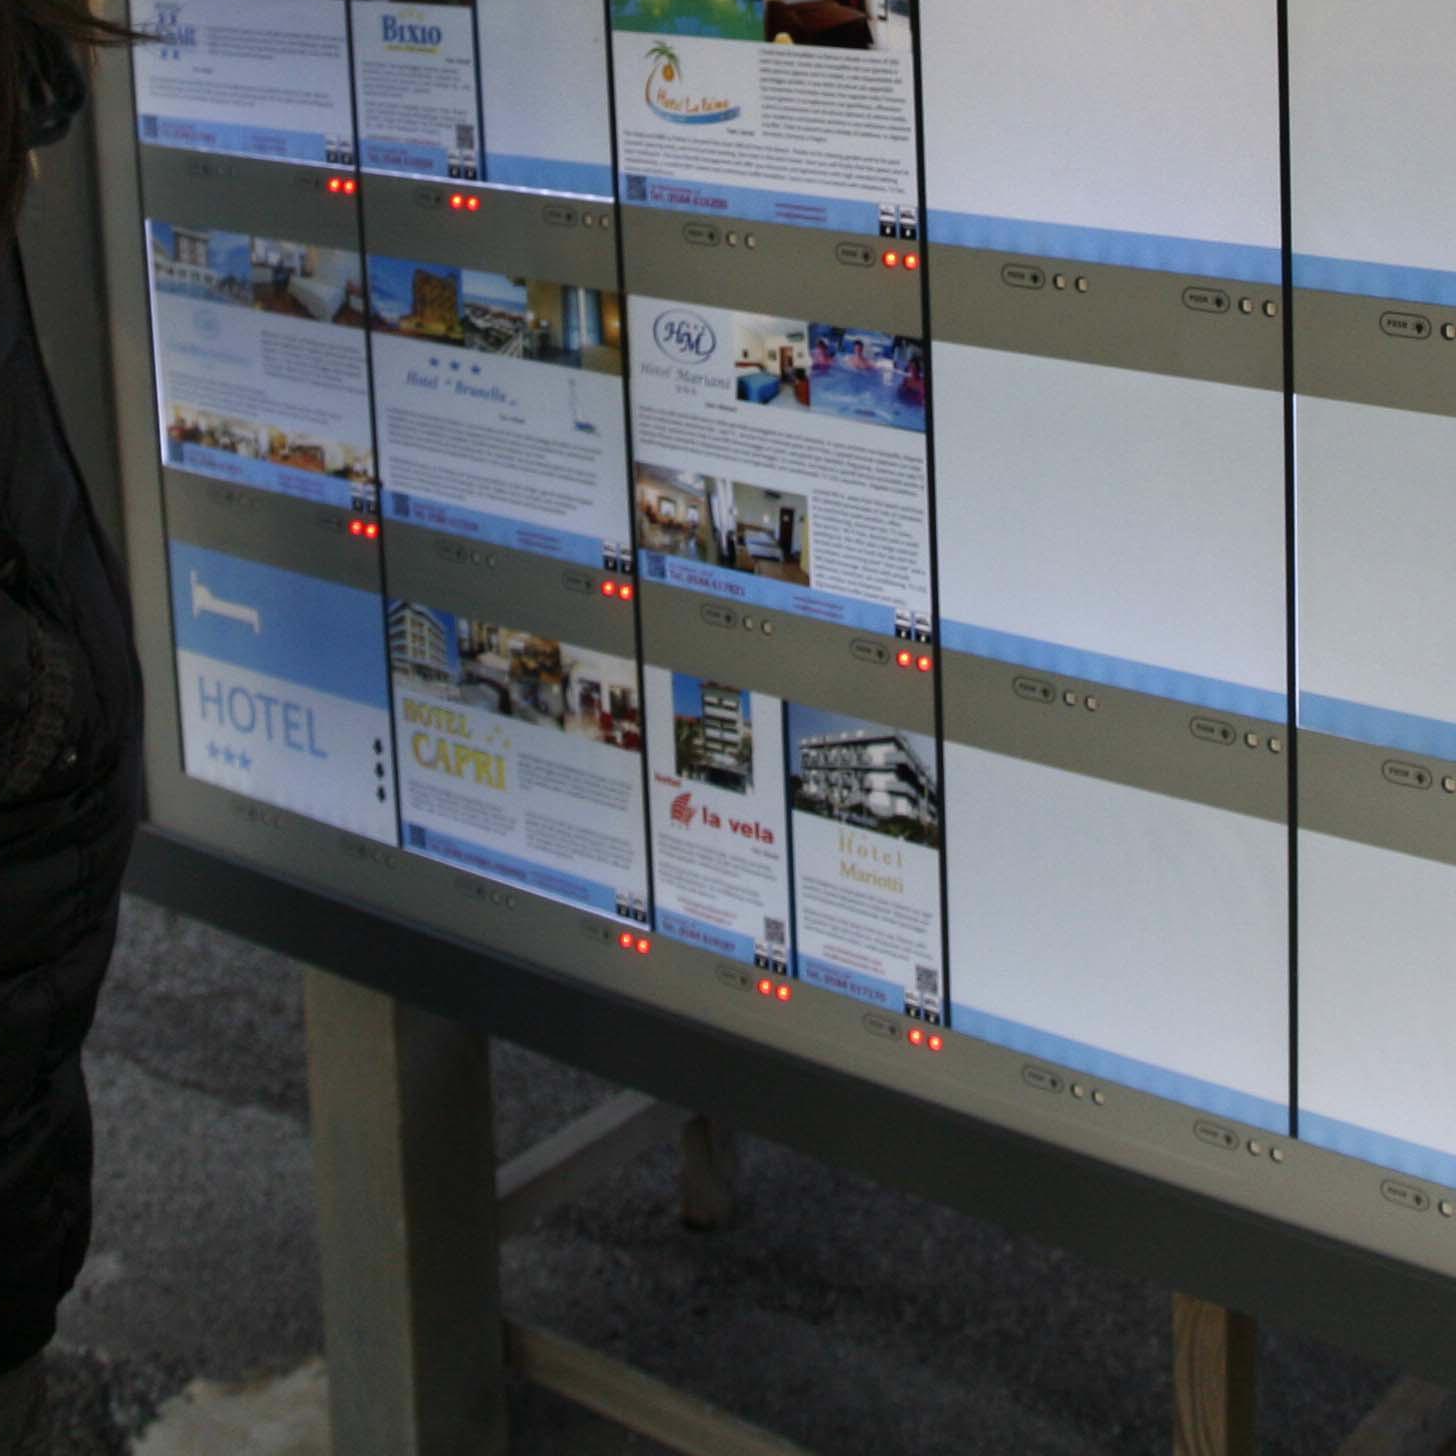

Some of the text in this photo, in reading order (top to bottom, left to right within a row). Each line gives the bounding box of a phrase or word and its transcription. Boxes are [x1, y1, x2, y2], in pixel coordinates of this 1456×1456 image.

[197, 675, 328, 759] HOTEL
[402, 697, 472, 739] HOTEL
[412, 730, 506, 791] CAPRI
[702, 805, 775, 844] la vela
